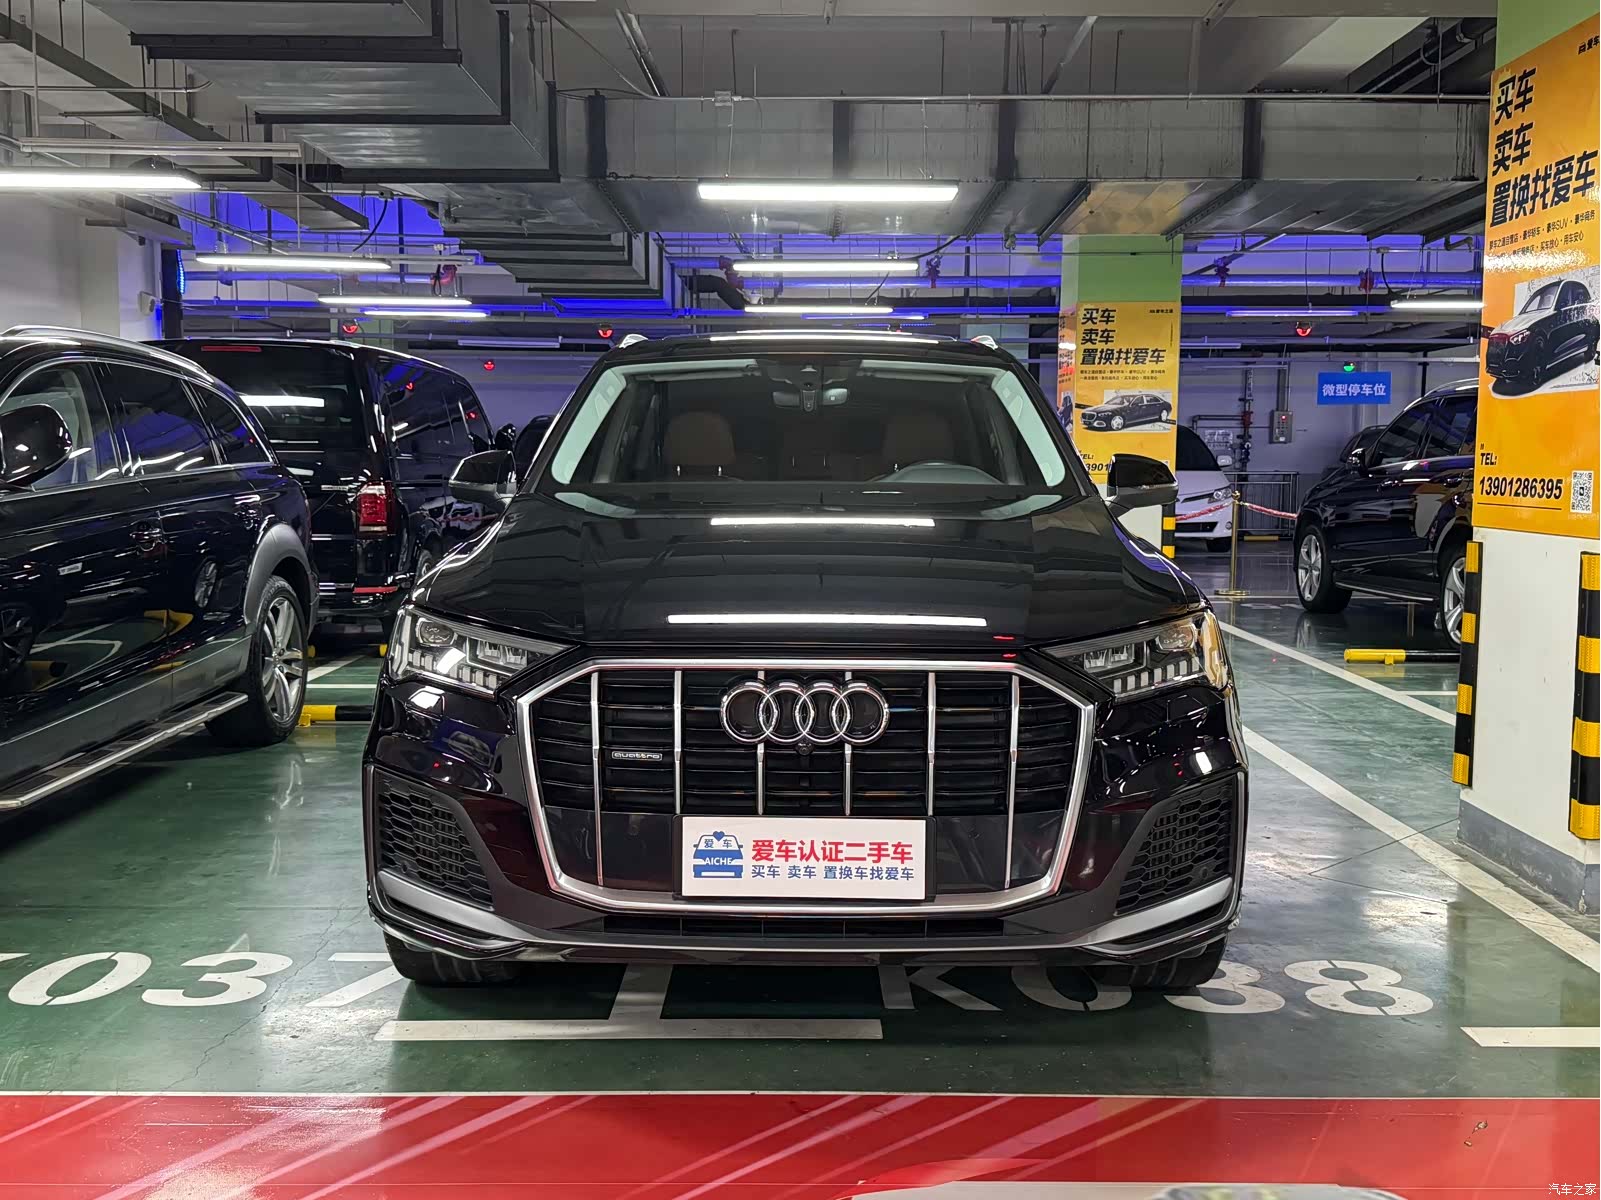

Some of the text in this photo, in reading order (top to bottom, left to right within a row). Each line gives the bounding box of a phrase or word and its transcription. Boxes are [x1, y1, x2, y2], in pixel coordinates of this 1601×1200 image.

[1494, 67, 1537, 125] 买车
[1491, 121, 1534, 176] 卖车
[1490, 150, 1599, 228] 置换找爱车
[1081, 308, 1117, 325] 买车
[1081, 328, 1116, 345] 卖车
[1080, 348, 1166, 365] 置换找爱车
[1322, 383, 1387, 397] 微型停车位
[1480, 452, 1498, 466] TEL:
[1479, 476, 1564, 500] 13901286395
[613, 752, 661, 760] quattro
[751, 839, 914, 864] 爱车认证二手车
[705, 857, 732, 865] AICHE
[751, 864, 915, 881] 买车 卖车 置换车找爱车
